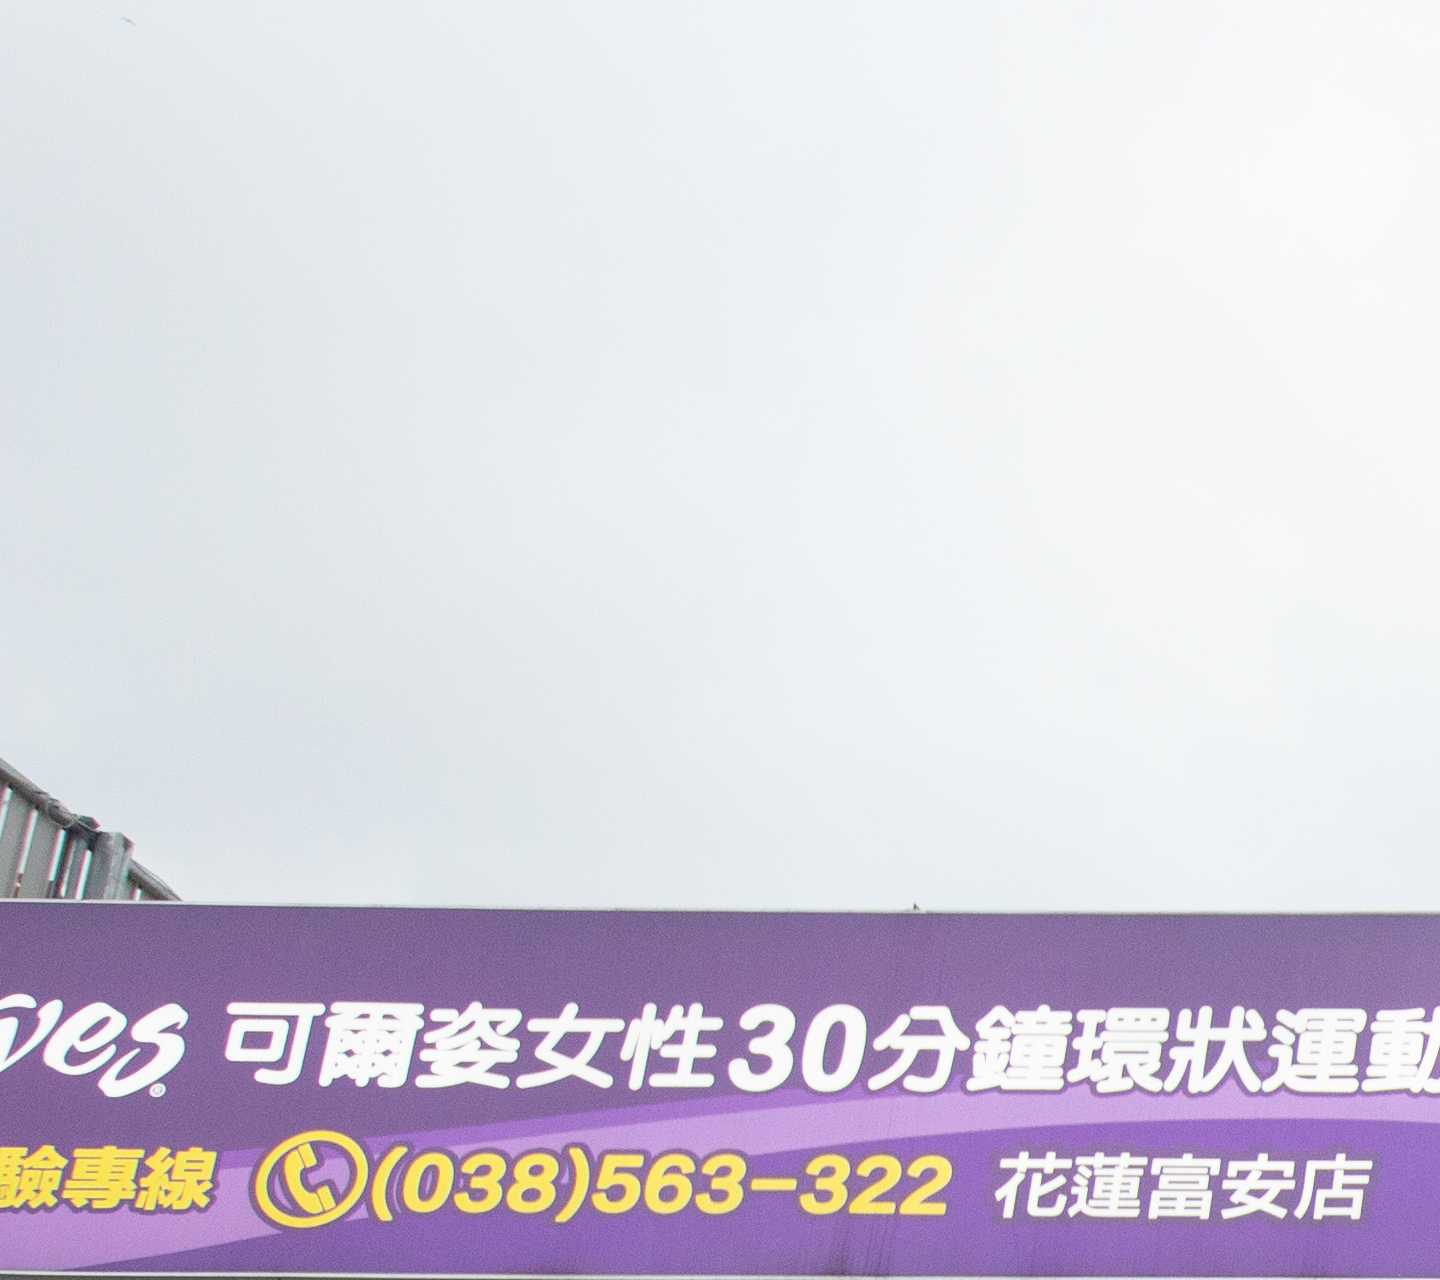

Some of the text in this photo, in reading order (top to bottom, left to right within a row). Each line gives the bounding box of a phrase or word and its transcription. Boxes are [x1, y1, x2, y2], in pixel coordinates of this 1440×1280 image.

[371, 1145, 954, 1224] (038)563-322
[996, 1152, 1374, 1224] 花蓮富安店
